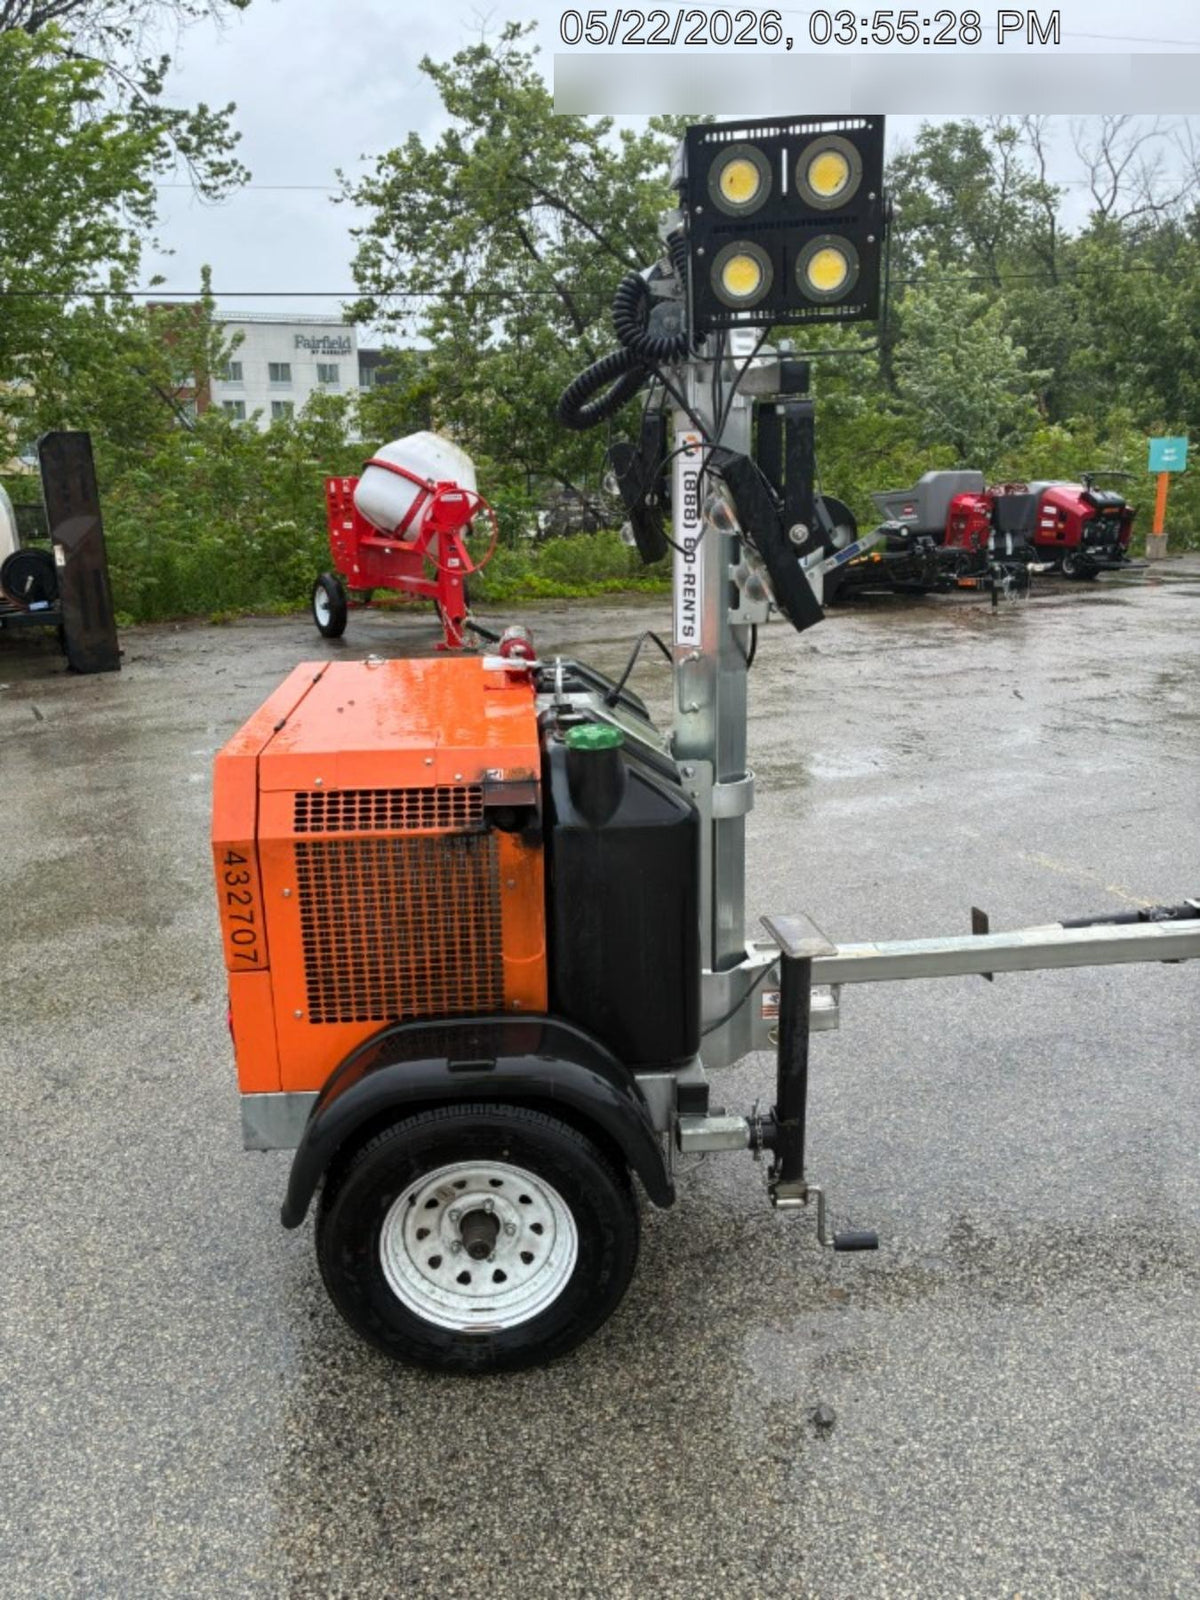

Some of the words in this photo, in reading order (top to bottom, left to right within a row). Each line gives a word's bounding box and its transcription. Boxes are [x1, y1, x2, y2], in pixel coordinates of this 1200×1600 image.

[294, 334, 352, 349] Fairfield
[683, 470, 698, 530] (888)
[223, 850, 259, 964] 432707
